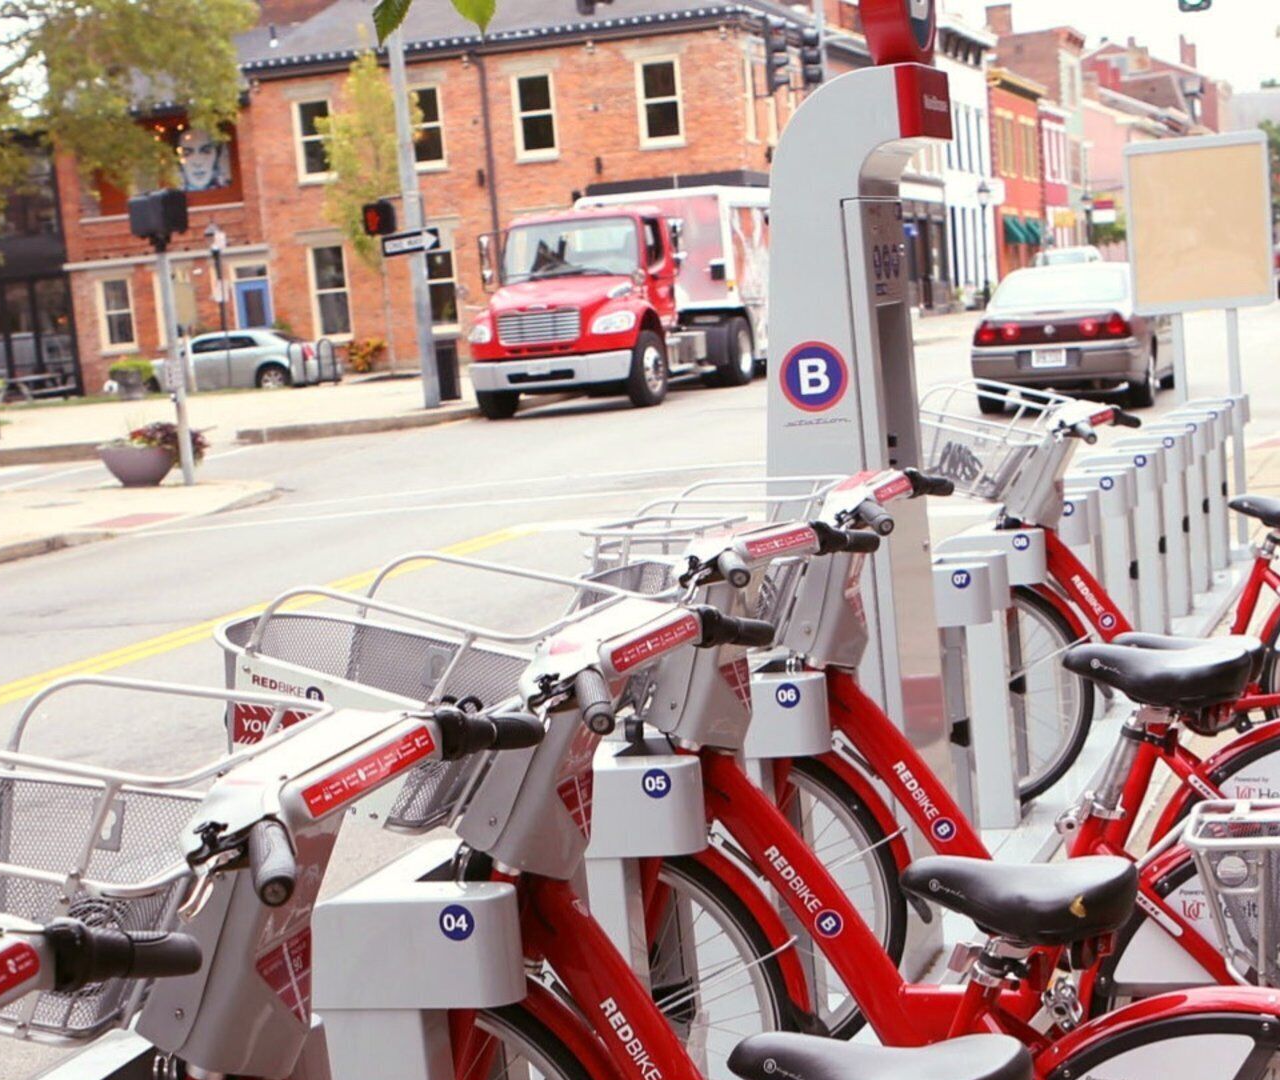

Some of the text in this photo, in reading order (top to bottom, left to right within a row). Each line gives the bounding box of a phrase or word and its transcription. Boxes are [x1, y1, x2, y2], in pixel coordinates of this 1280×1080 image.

[798, 357, 830, 395] B
[953, 574, 967, 584] 07
[252, 674, 305, 698] REDBIKE
[777, 689, 796, 702] 06
[645, 776, 666, 791] 05
[892, 760, 951, 836] REDBIKE B
[764, 845, 836, 932] REDBIKE B
[443, 913, 468, 932] 04
